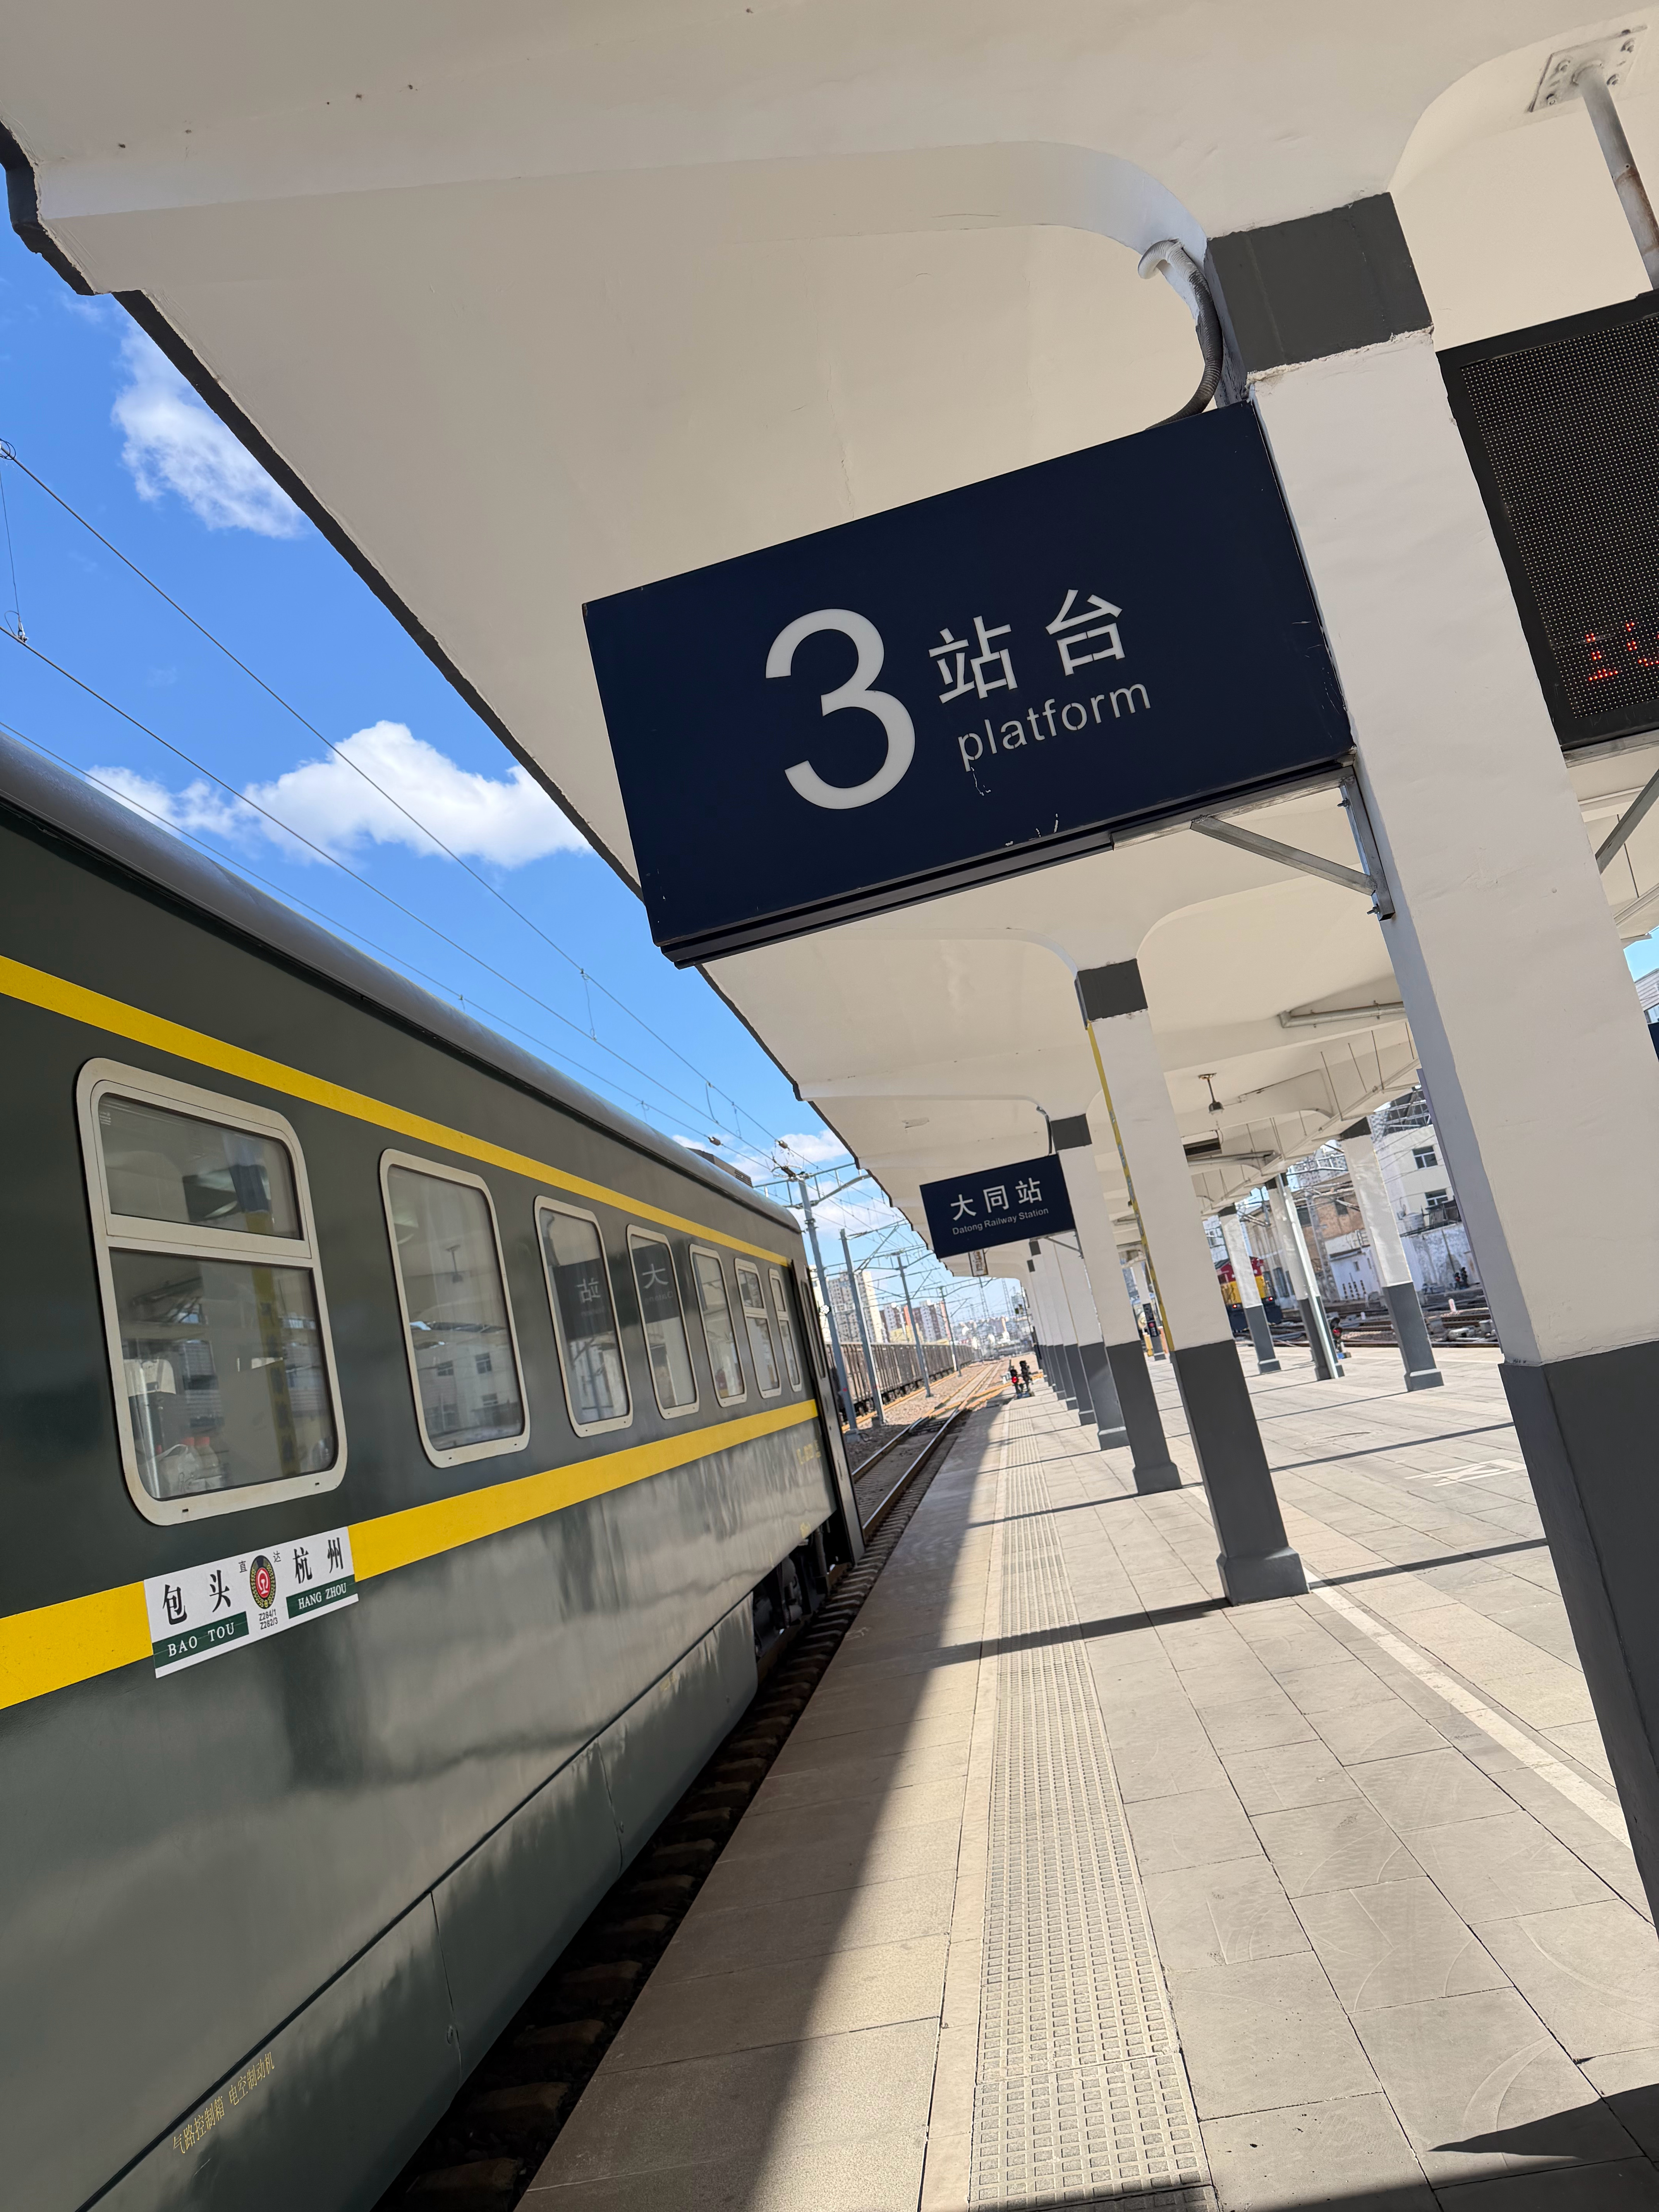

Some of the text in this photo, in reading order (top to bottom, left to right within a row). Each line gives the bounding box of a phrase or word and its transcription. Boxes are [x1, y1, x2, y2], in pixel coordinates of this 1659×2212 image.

[929, 589, 1126, 704] 站台
[765, 608, 915, 810] 3
[958, 683, 1151, 772] platform
[950, 1177, 1042, 1221] 大同站
[952, 1208, 1049, 1235] Datong Railway Station
[162, 1537, 343, 1625] 包头 杭州
[298, 1582, 347, 1610] HANG ZHOU
[258, 1608, 276, 1621] Z284/1
[260, 1617, 278, 1630] Z282/3
[167, 1622, 235, 1657] BAO TOU
[173, 2051, 275, 2154] 气路控制箱 电空制动机
